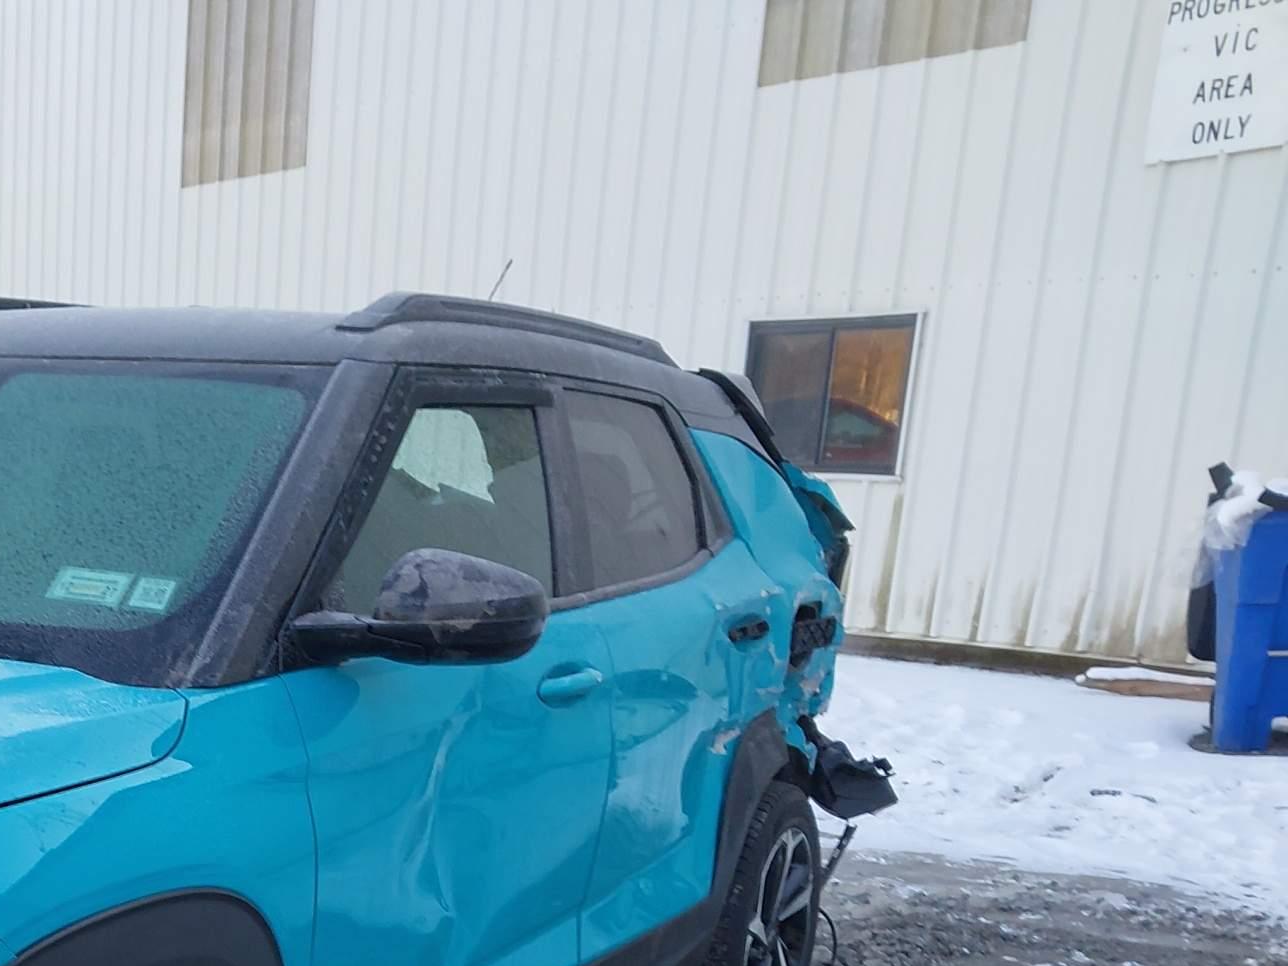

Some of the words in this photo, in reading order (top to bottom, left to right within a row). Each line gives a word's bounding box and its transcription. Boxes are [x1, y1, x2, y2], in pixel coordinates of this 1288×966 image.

[1214, 27, 1259, 57] VIC
[1192, 72, 1253, 105] AREA
[1191, 113, 1252, 145] ONLY
